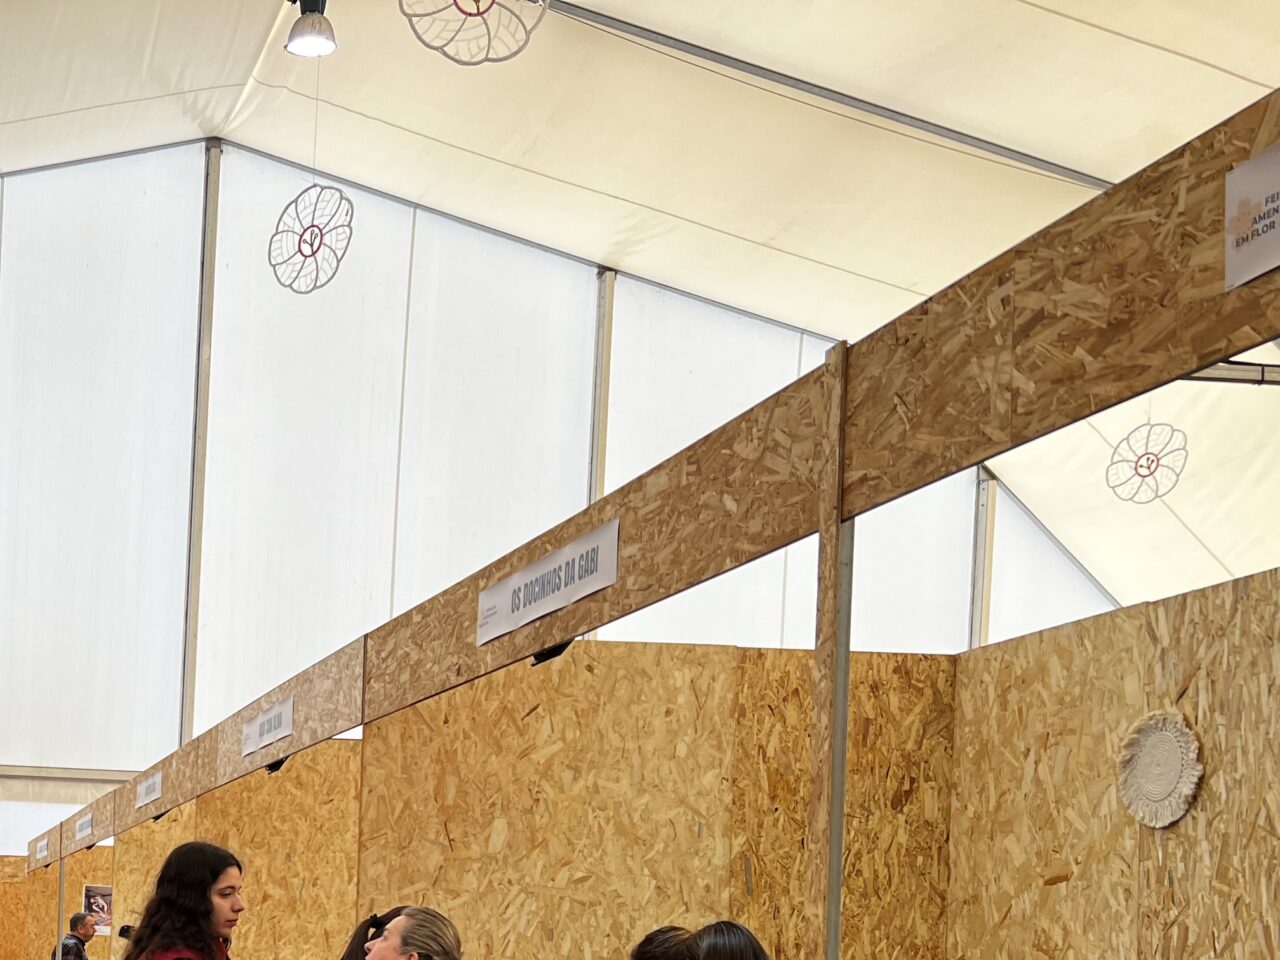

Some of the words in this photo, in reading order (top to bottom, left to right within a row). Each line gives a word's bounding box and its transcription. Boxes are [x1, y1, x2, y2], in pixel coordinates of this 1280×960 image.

[1265, 191, 1280, 207] FEI
[1252, 205, 1280, 225] AMEN
[1235, 233, 1249, 248] EM
[1251, 220, 1276, 240] FLOR
[511, 586, 522, 614] OS
[522, 564, 563, 609] DOCINHOS
[564, 558, 575, 589] DA
[578, 545, 599, 581] GABI
